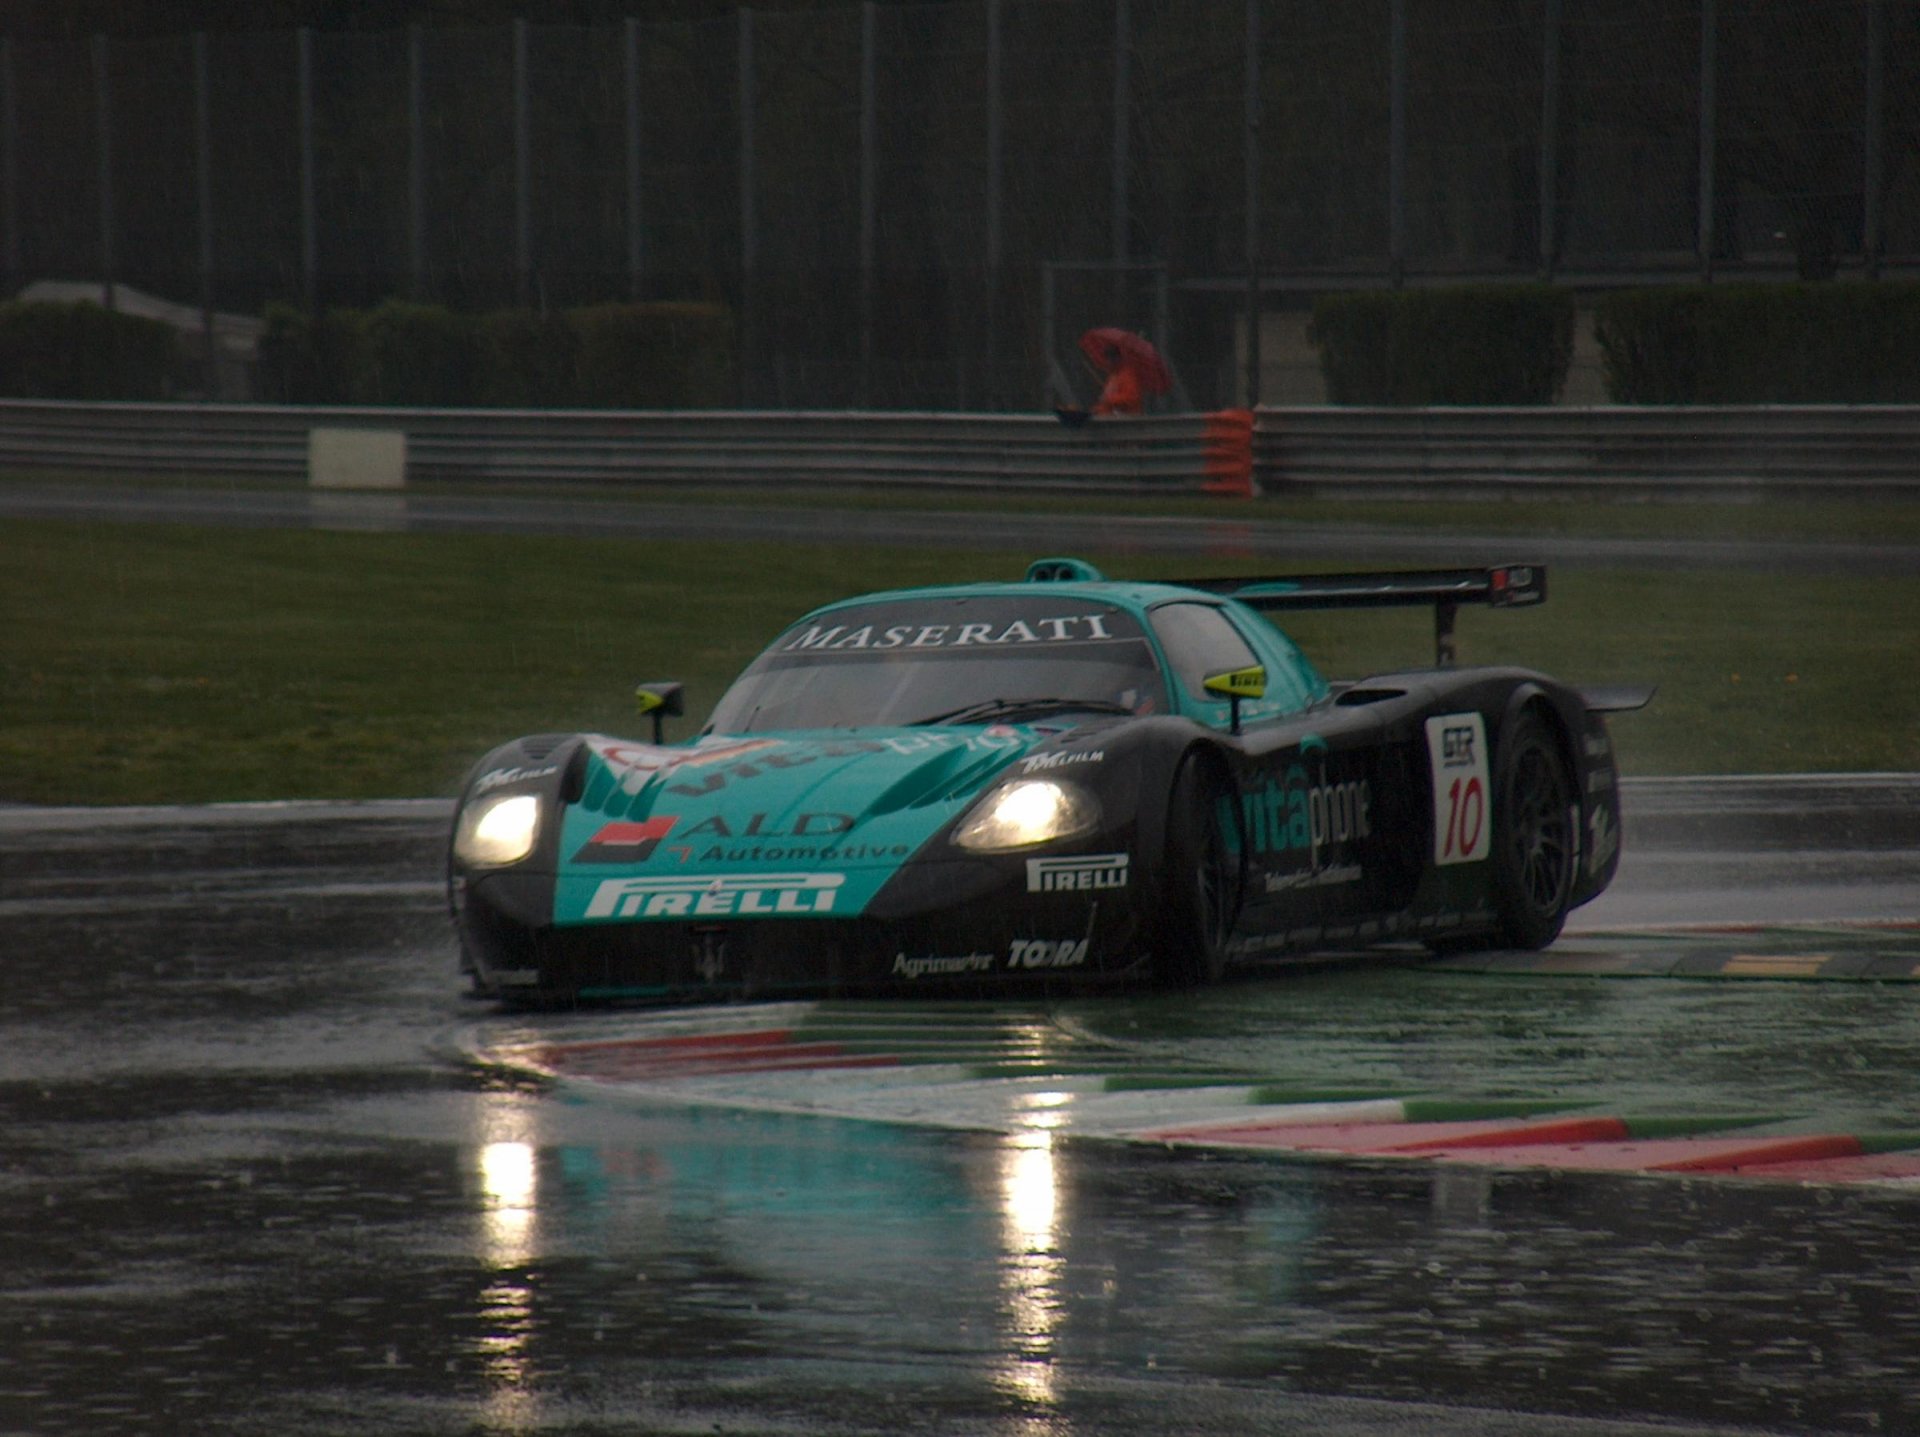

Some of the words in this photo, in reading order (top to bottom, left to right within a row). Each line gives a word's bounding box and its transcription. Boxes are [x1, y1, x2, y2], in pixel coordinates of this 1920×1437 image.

[784, 614, 1113, 651] MASERATI
[676, 812, 855, 840] ALD
[1444, 775, 1483, 857] 10
[700, 843, 910, 863] Automotive
[1026, 852, 1129, 893] PIRELLI
[583, 872, 846, 919] PIRELLI
